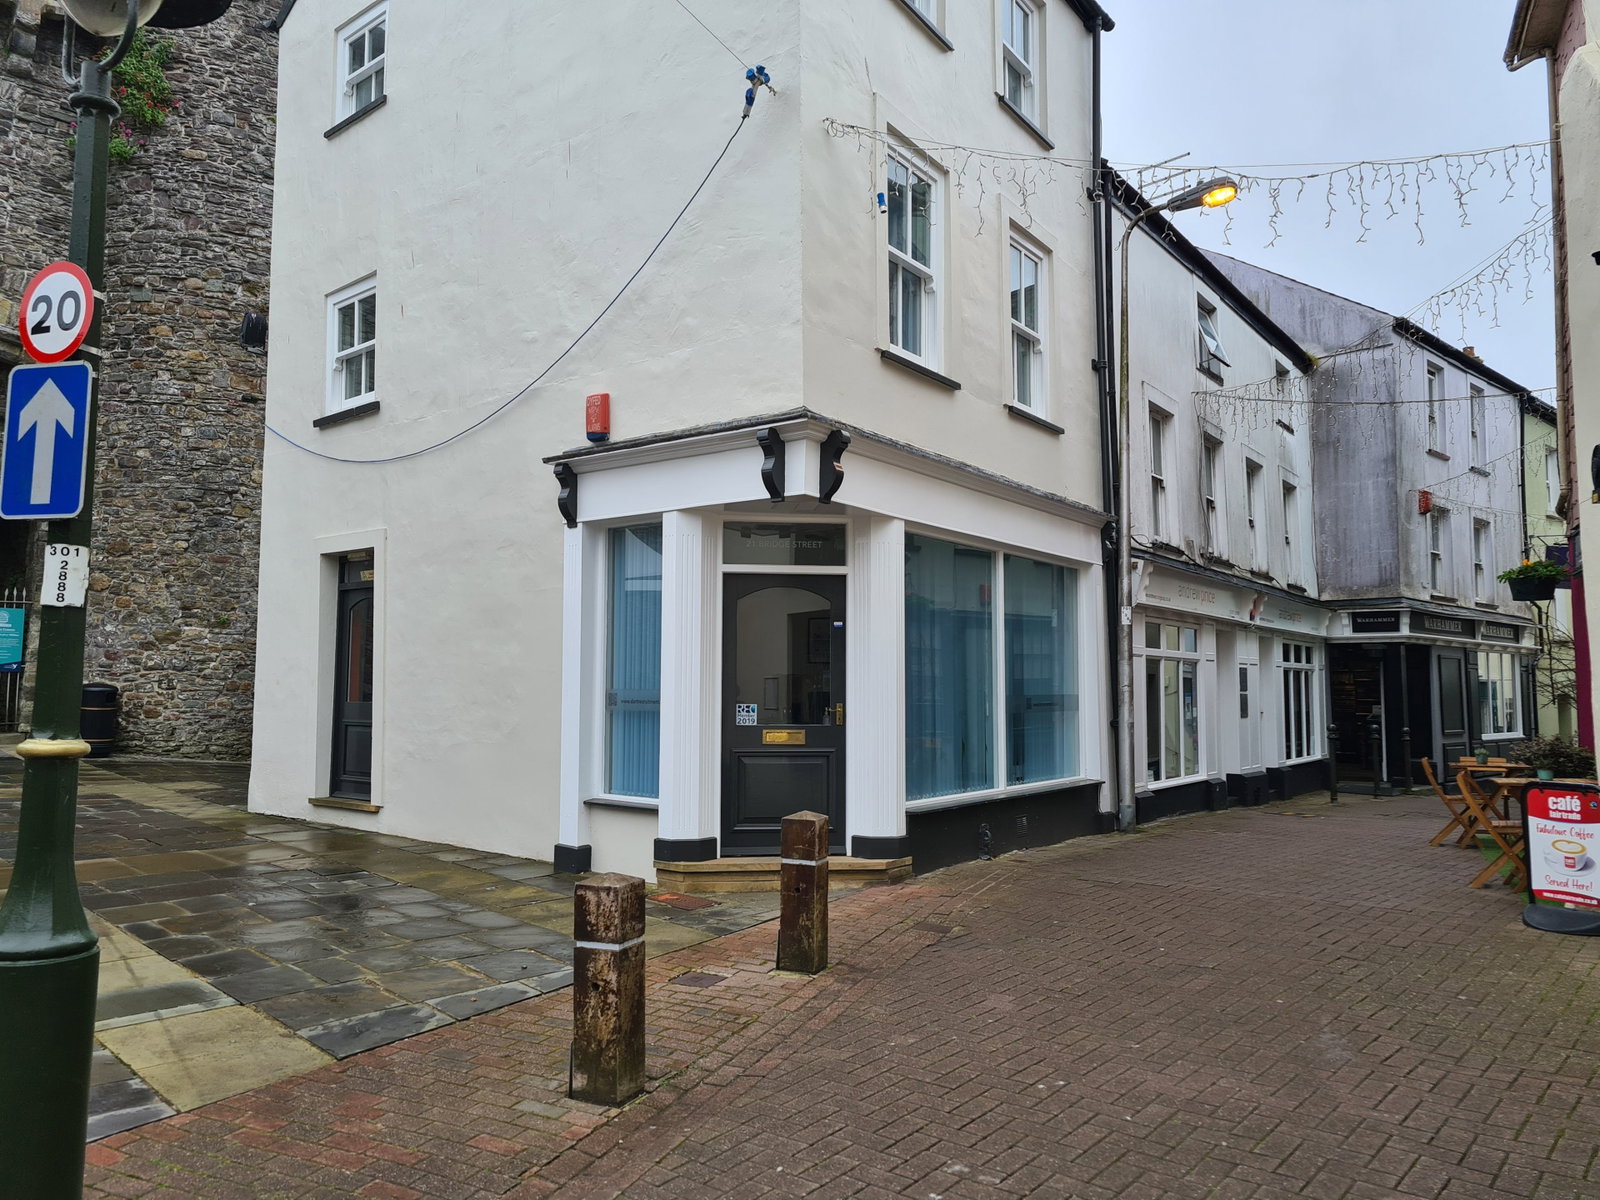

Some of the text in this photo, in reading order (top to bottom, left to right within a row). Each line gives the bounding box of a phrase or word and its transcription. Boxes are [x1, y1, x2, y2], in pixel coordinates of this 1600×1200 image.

[31, 290, 81, 335] 20
[50, 546, 80, 557] 301
[1424, 615, 1462, 632] WARHAMMER
[1547, 795, 1581, 812] café
[1536, 823, 1594, 840] Fabulous Coffee
[1545, 874, 1593, 892] Served Here!
